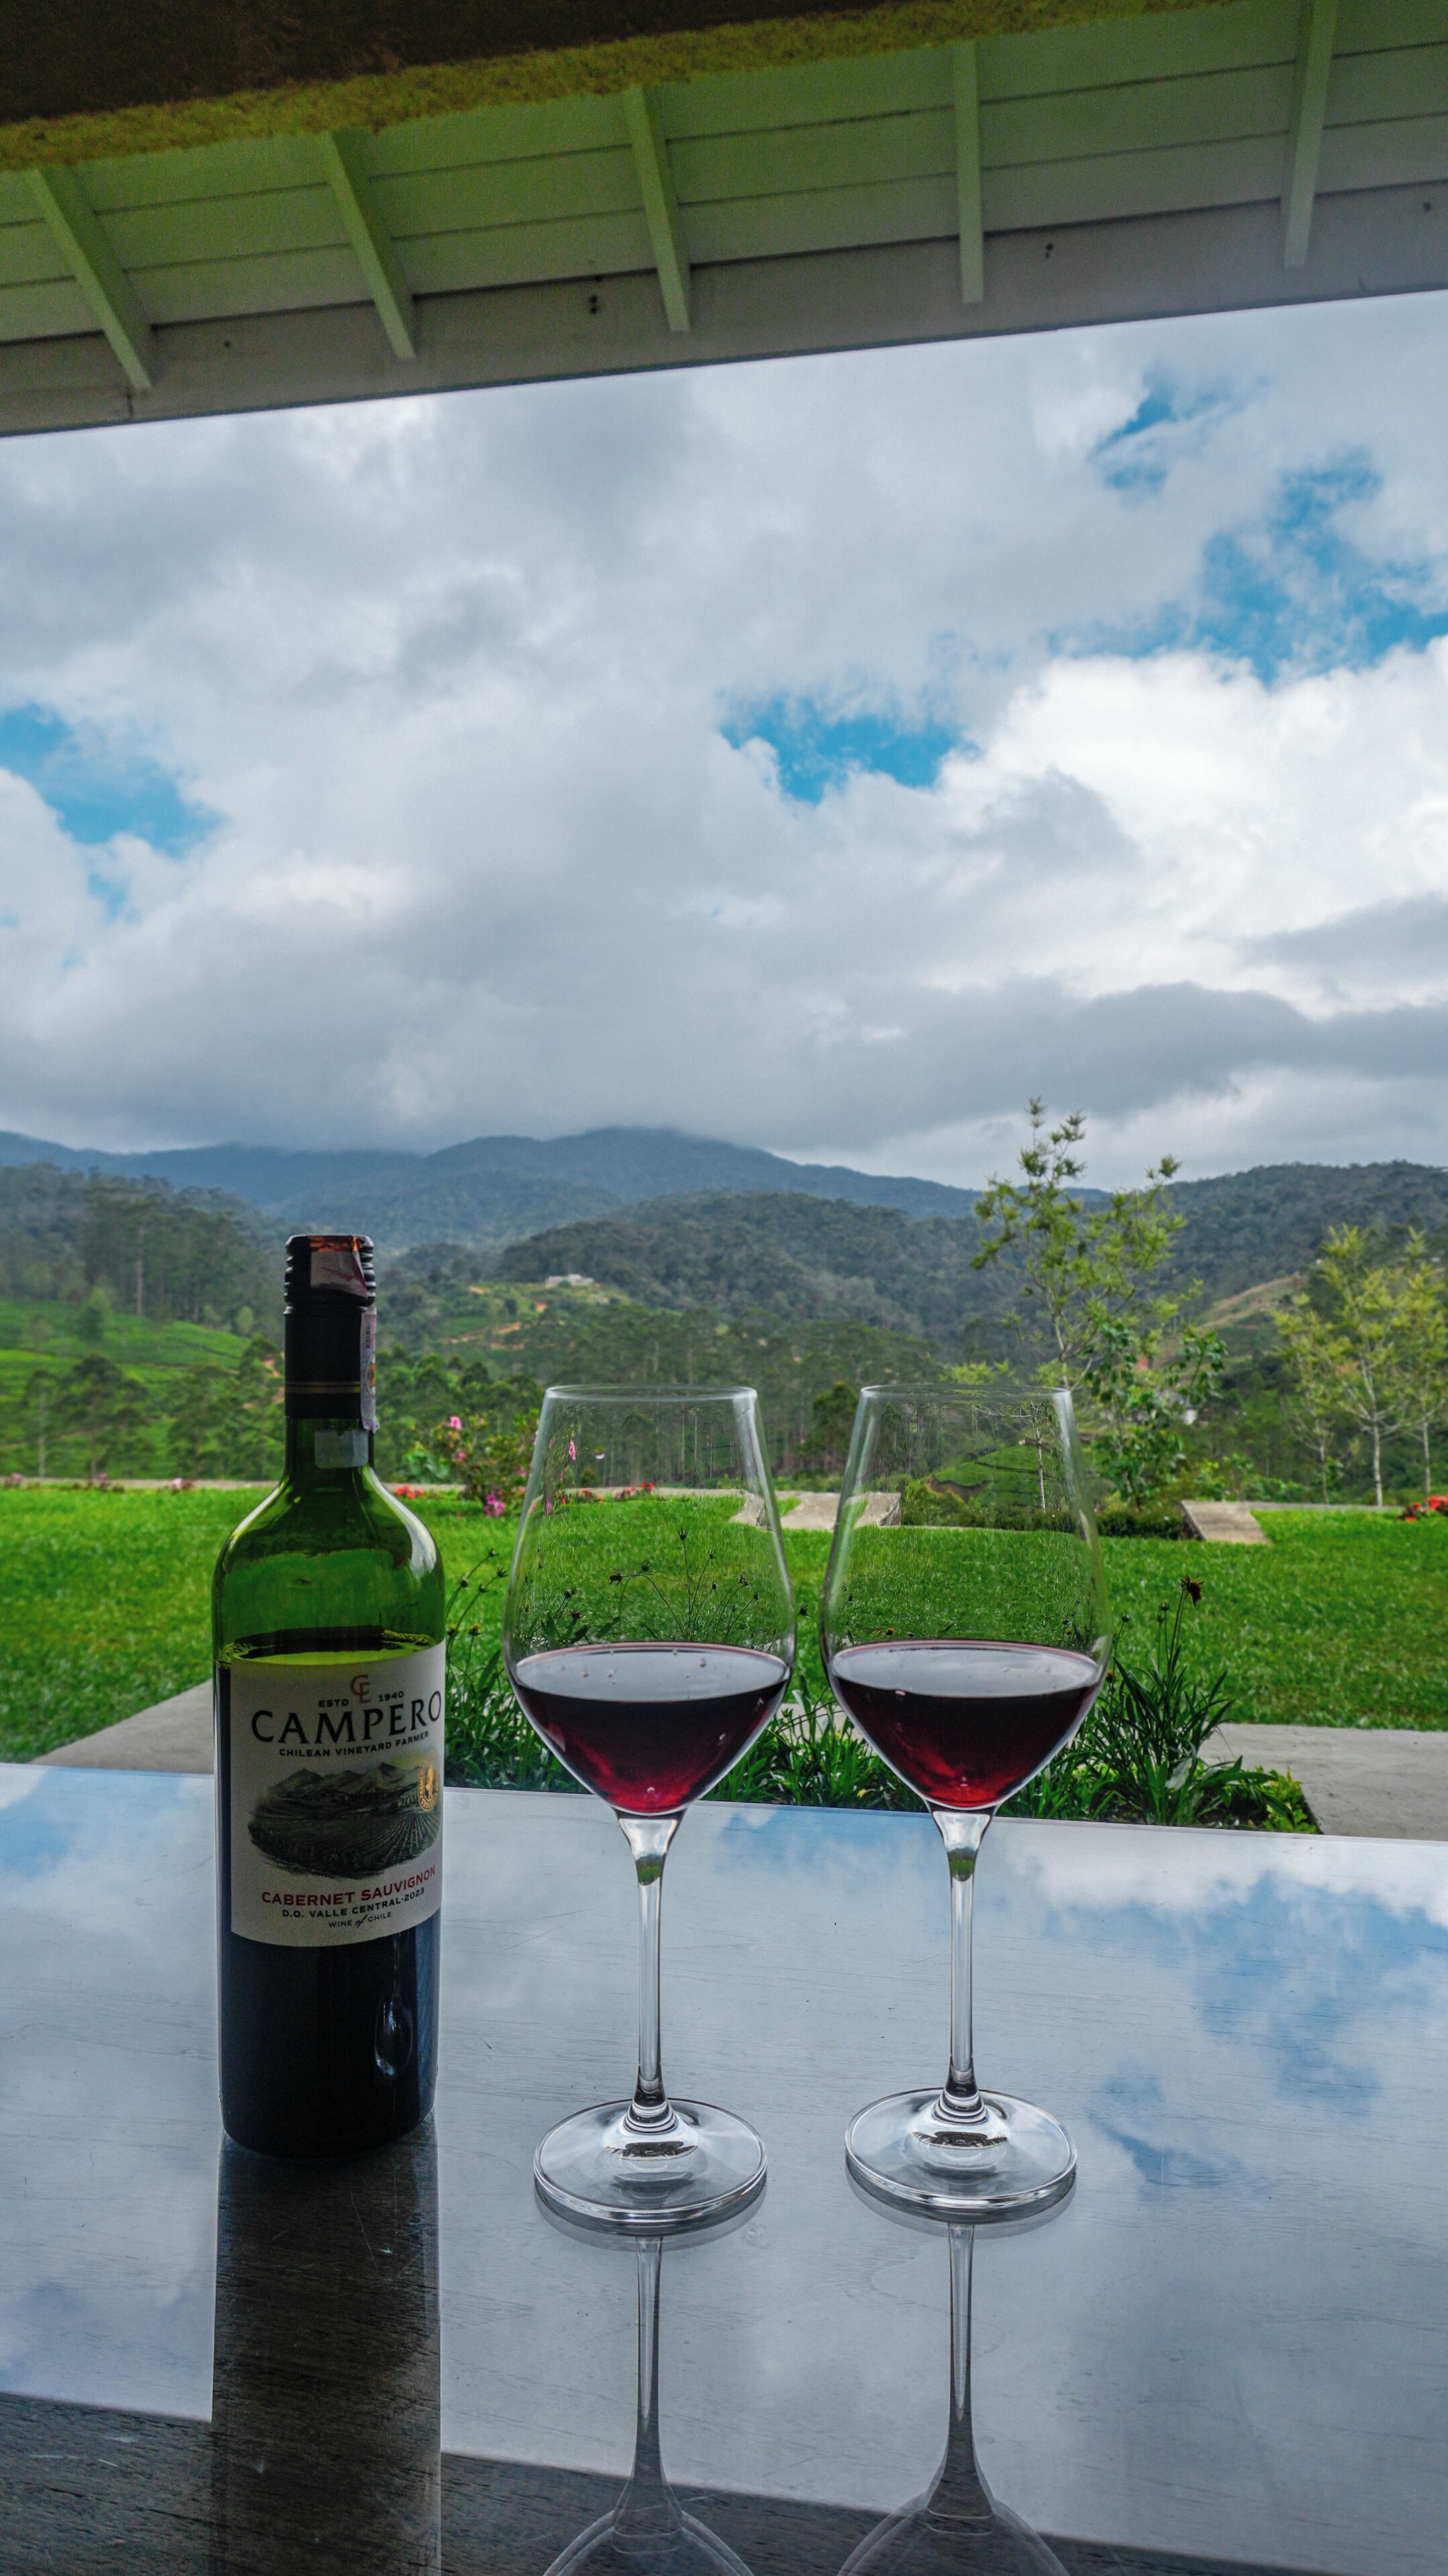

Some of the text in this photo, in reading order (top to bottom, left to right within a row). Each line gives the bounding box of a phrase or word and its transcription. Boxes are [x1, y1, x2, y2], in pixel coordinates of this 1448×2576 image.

[318, 1690, 405, 1708] ESTD 1940
[251, 1690, 442, 1744] CAMPERO
[279, 1731, 429, 1757] CHILEAN VINEYARD FARMER
[262, 1864, 435, 1907] CABERNET SAUVIGNON
[282, 1909, 304, 1918] D.O.
[309, 1907, 347, 1917] VALLE
[328, 1919, 352, 1928] WINE
[367, 1911, 392, 1923] CHILE
